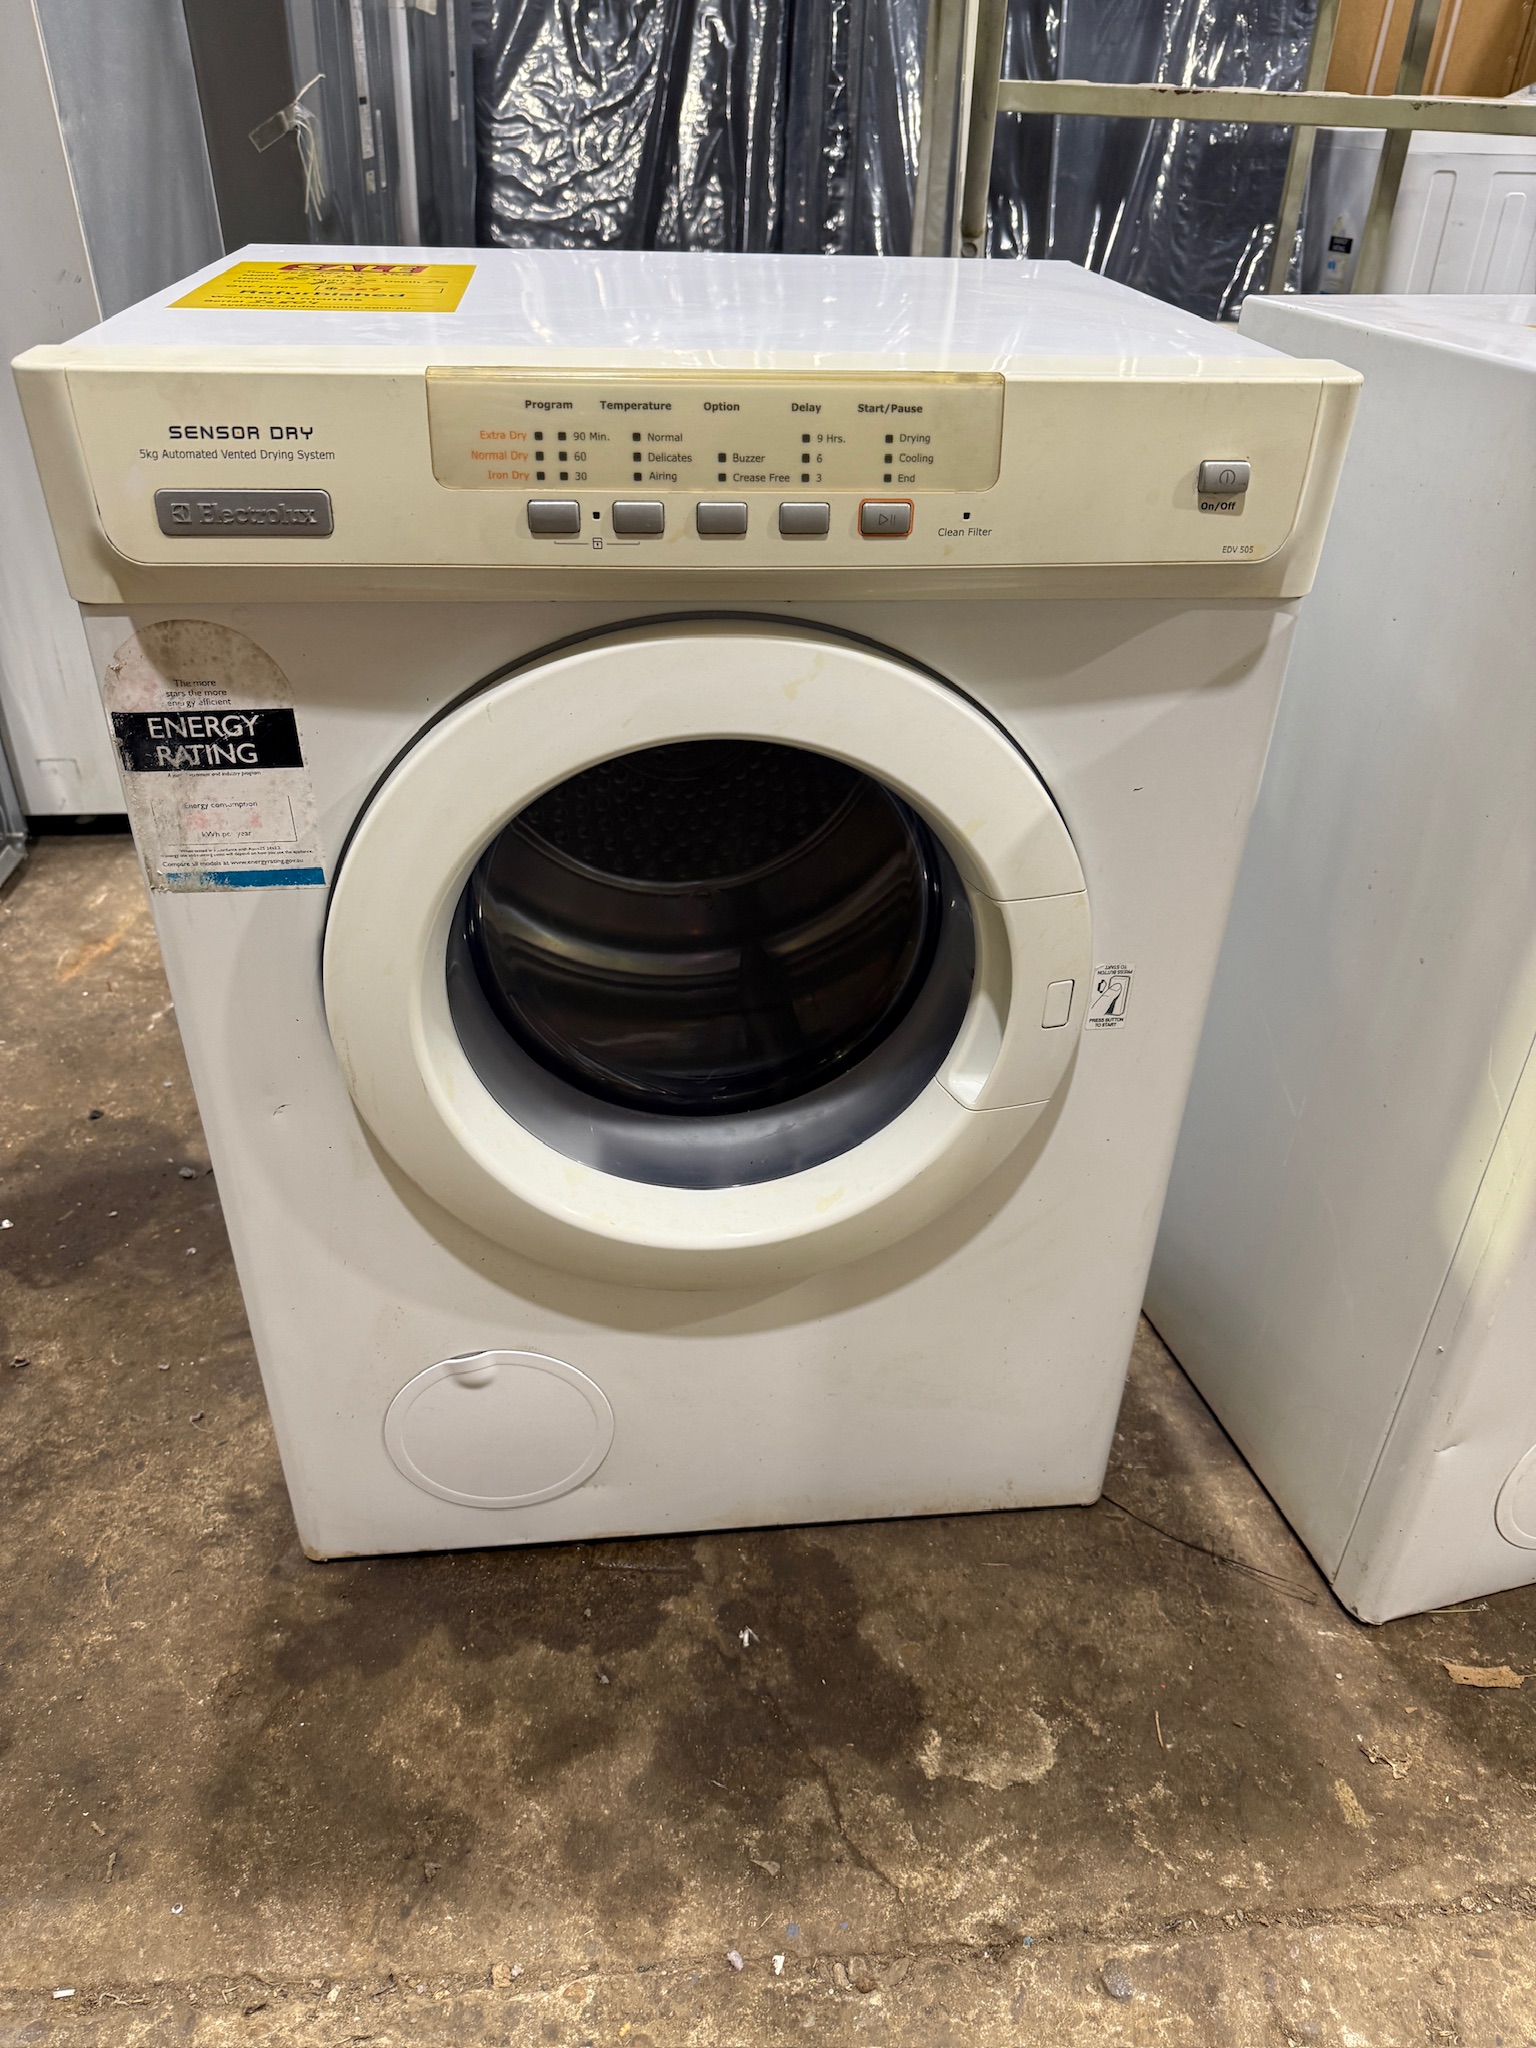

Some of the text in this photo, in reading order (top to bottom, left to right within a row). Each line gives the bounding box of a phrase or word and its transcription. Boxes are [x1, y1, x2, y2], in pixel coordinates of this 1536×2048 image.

[292, 264, 419, 273] SALE
[525, 400, 573, 411] Program
[600, 401, 672, 411] Temperature
[704, 402, 740, 412] Option
[791, 403, 821, 413] Delay
[857, 404, 923, 414] Start/Pause
[168, 425, 313, 440] SENSOR DRY
[480, 431, 527, 442] Extra Dry
[573, 431, 610, 441] 90 Min.
[648, 433, 683, 442] Normal
[817, 434, 846, 443] 9 Hrs.
[899, 434, 931, 445] Drying
[139, 449, 335, 461] 5kg Automated Vented Drying System
[471, 451, 528, 462] Normal Dry
[574, 452, 587, 461] 60
[648, 452, 693, 462] Delicates
[732, 453, 765, 463] Buzzer
[817, 454, 823, 463] 6
[899, 454, 934, 464] Cooling
[488, 471, 530, 482] Iron Dry
[575, 472, 587, 481] 30
[649, 472, 678, 482] Airing
[733, 473, 790, 483] Crease Free
[816, 474, 822, 483] 3
[898, 474, 916, 483] End
[1201, 501, 1236, 512] On/Off
[197, 502, 318, 525] Electrolux
[937, 527, 993, 537] Clean Filter
[1222, 545, 1254, 554] EDV 505
[174, 679, 191, 687] The
[166, 690, 186, 698] stars
[198, 698, 232, 706] efficient
[147, 714, 260, 739] ENERGY
[156, 743, 259, 766] RATING
